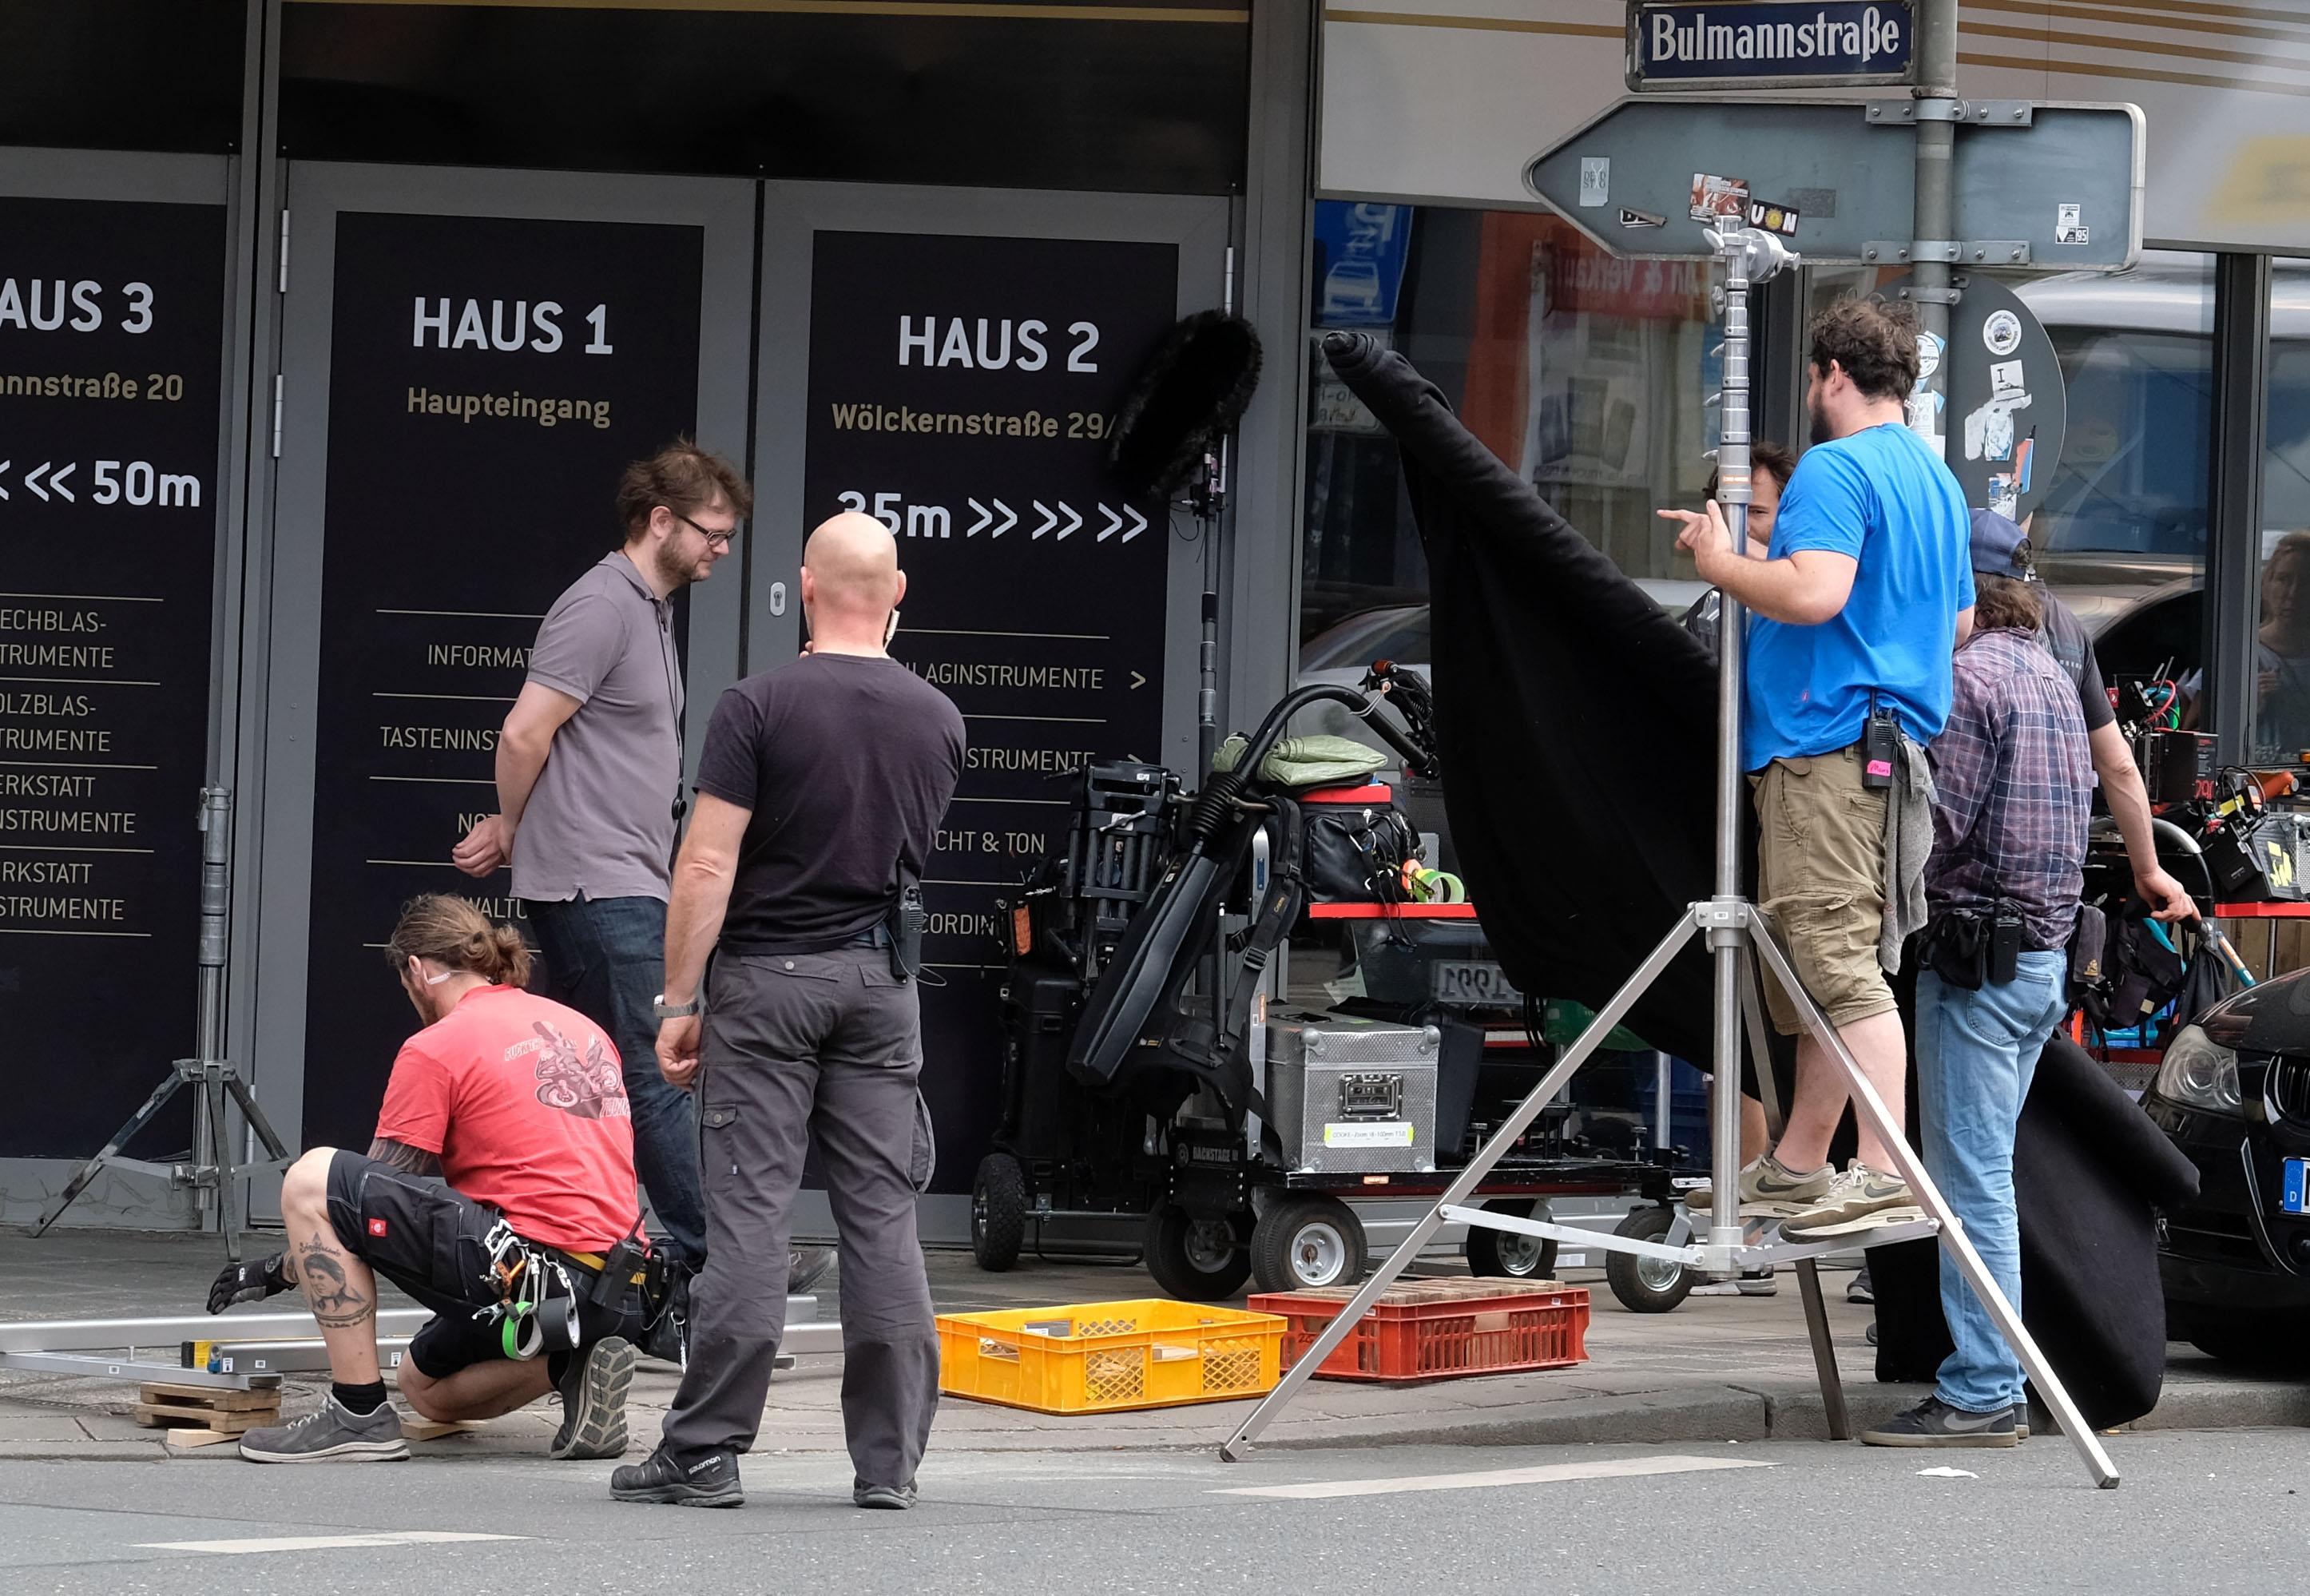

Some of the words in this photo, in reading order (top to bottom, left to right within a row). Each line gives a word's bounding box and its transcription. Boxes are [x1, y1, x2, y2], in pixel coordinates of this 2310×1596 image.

[1652, 6, 1899, 63] Bulmannstraße
[0, 278, 103, 332] AUS
[121, 282, 154, 334] 3
[413, 296, 563, 353] HAUS
[585, 304, 613, 355] 1
[899, 316, 1049, 372] HAUS
[1067, 321, 1100, 373] 2
[0, 371, 138, 399] nnstraße
[147, 374, 183, 400] 20
[407, 387, 611, 429] Haupteingang
[832, 403, 1058, 438] Wölckernstraße
[93, 460, 200, 507] 50m
[380, 725, 501, 752] TASTENINS
[982, 832, 1000, 853] &
[1005, 832, 1046, 854] TON
[2289, 1191, 2297, 1202] D
